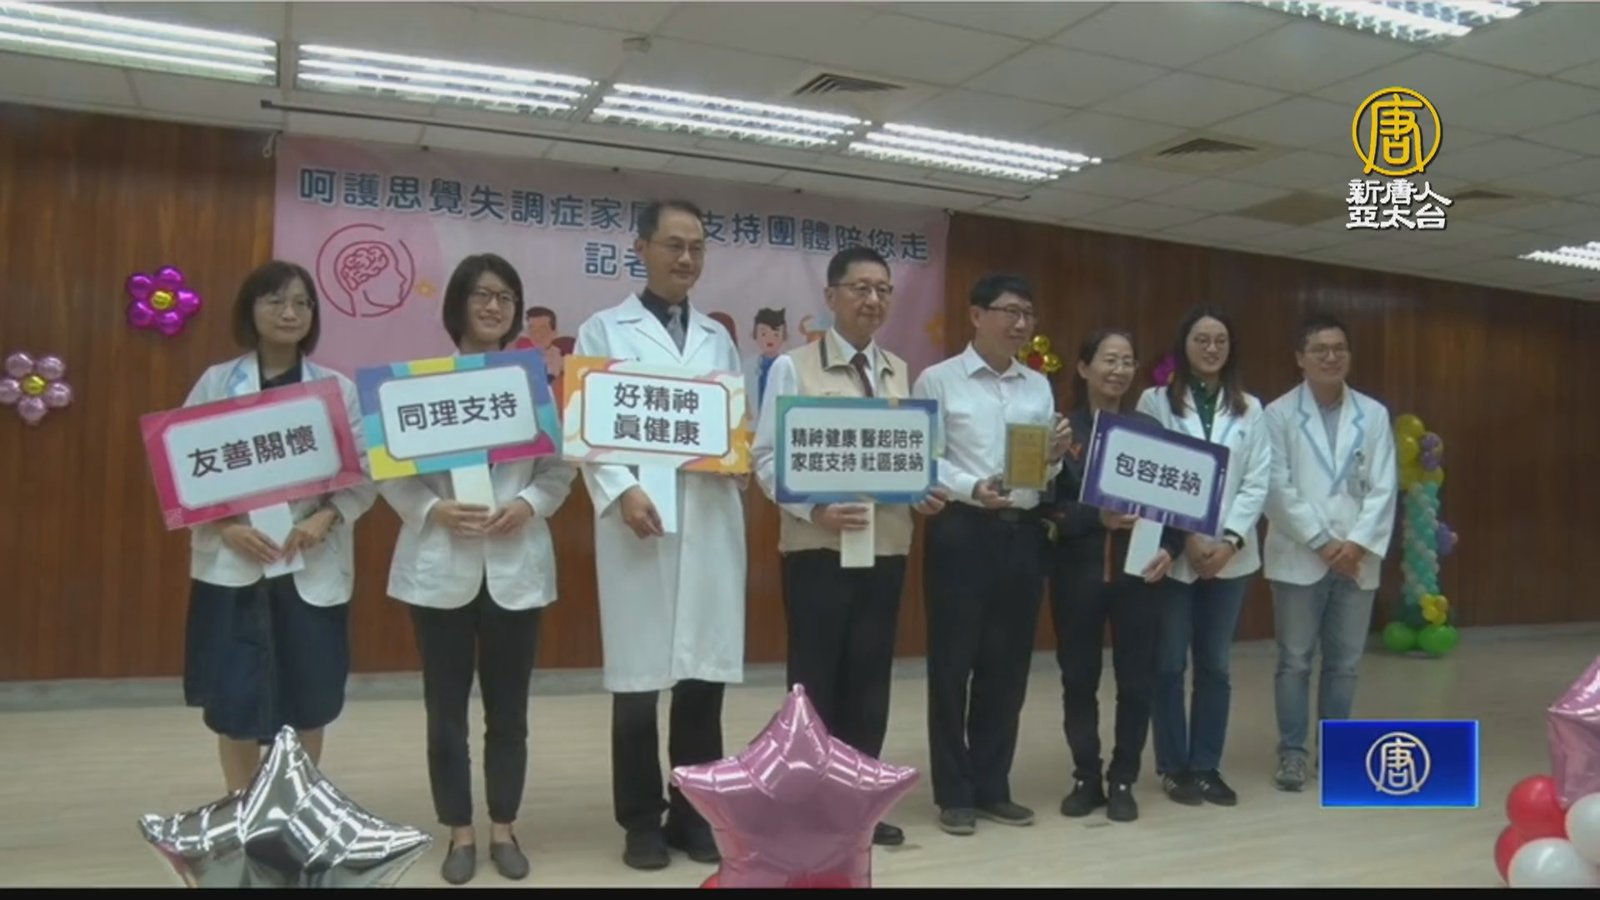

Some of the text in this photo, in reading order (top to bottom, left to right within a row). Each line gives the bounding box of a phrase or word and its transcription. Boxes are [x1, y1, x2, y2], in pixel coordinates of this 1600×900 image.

[398, 391, 518, 432] 同理支持
[614, 382, 700, 414] 好精神
[187, 424, 319, 477] 友善關懷
[791, 428, 924, 448] 精神健康 醫起陪伴
[791, 452, 924, 472] 家庭支持 社區接納
[1116, 453, 1202, 496] 包容接納
